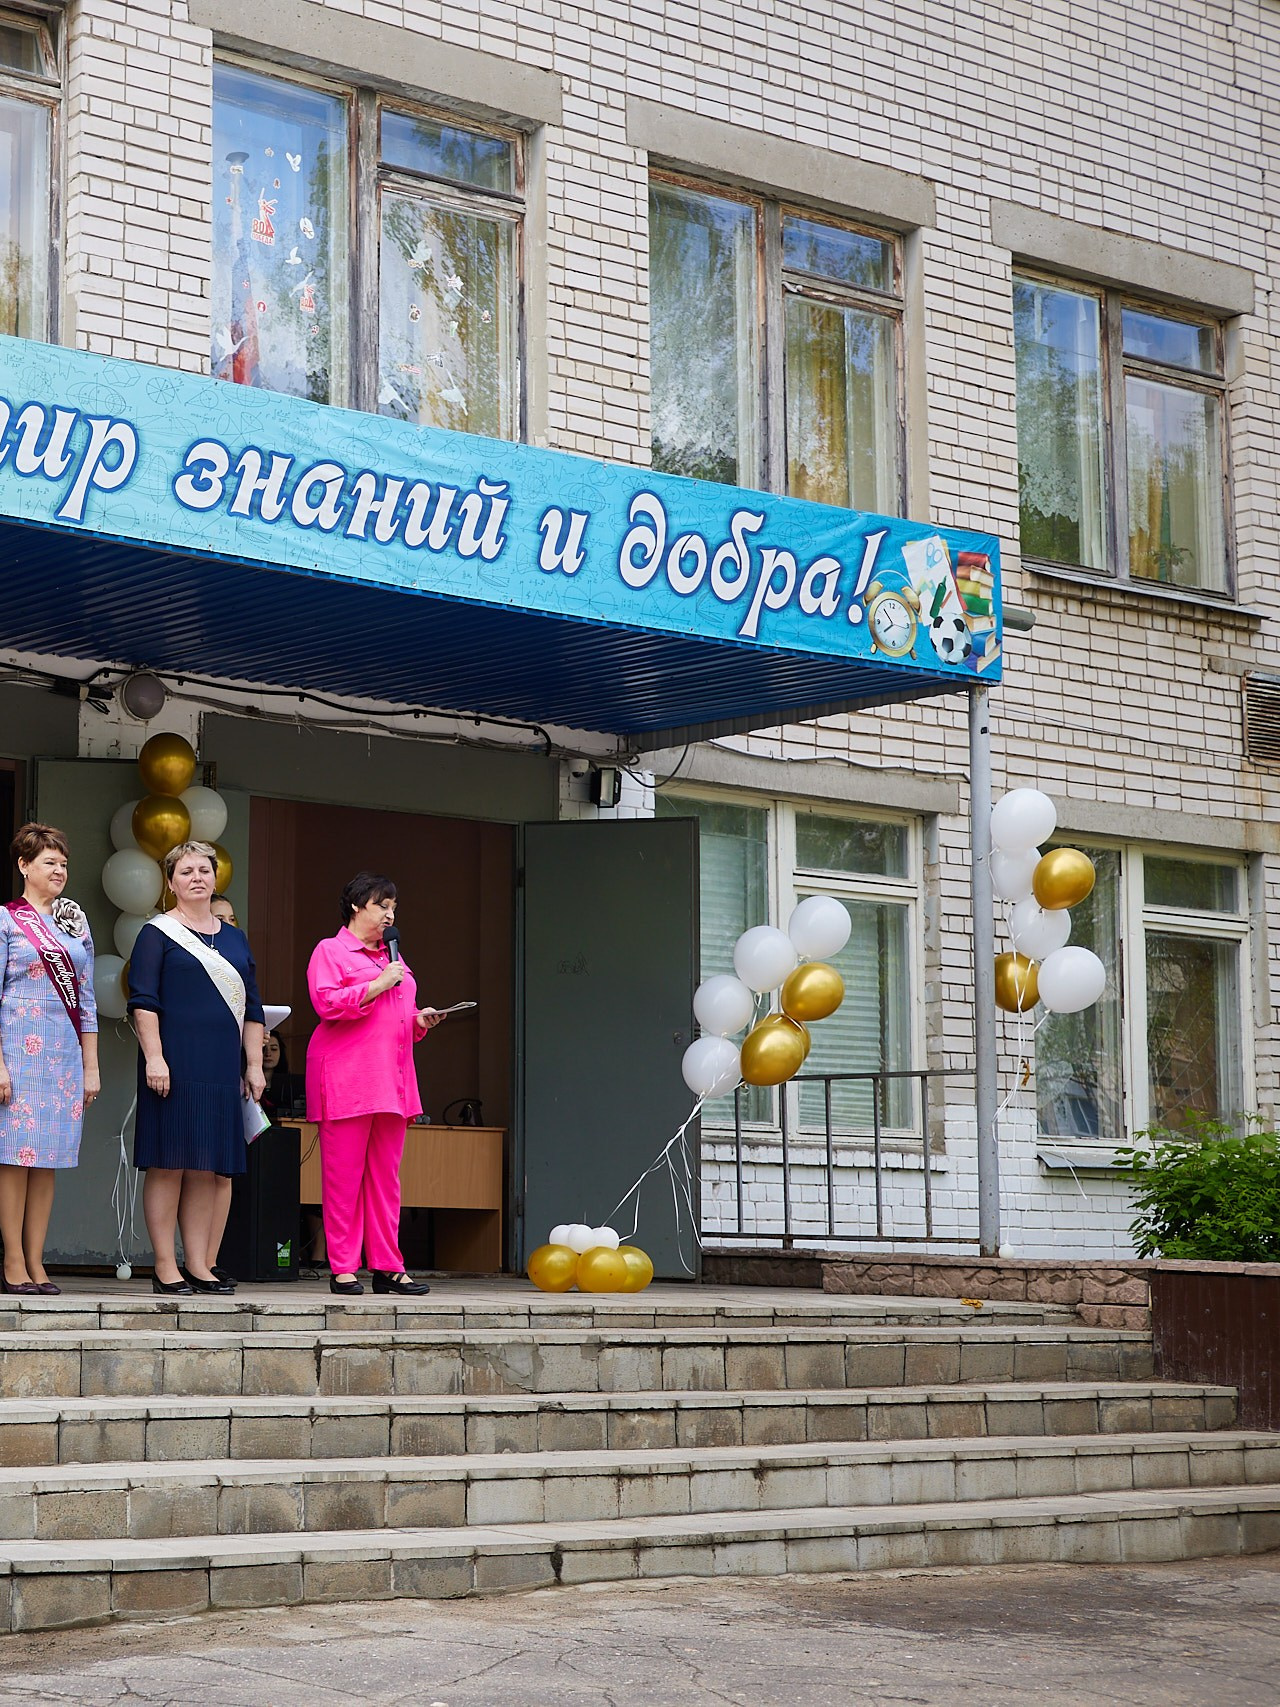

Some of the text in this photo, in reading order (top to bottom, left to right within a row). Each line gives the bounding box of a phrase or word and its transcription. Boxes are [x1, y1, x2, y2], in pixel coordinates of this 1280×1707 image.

[173, 438, 509, 562] знаний
[537, 505, 592, 575] и
[618, 491, 888, 639] добра!
